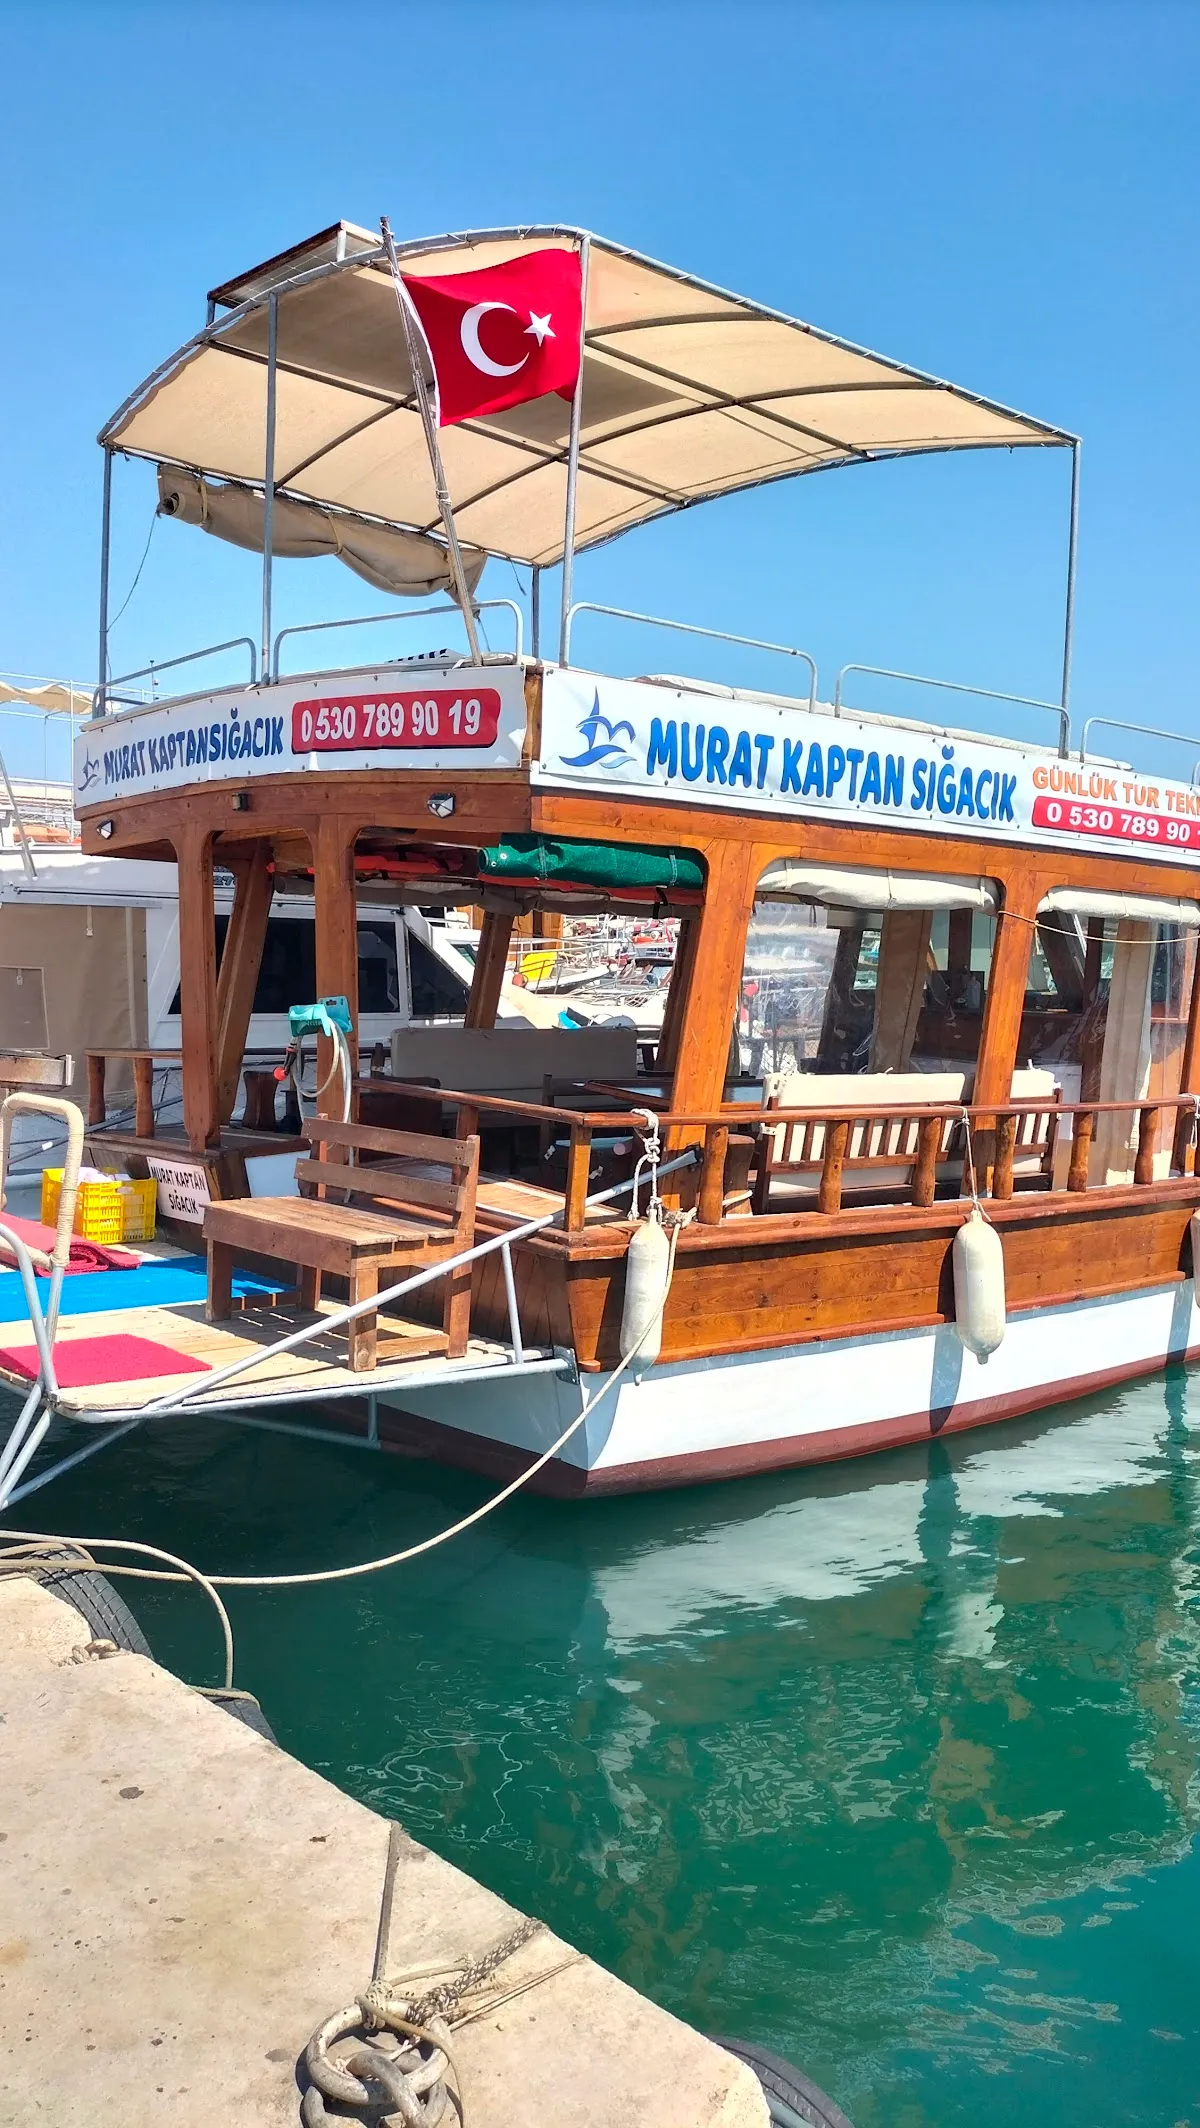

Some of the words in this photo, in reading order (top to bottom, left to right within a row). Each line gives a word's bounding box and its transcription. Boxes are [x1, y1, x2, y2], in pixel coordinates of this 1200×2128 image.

[302, 710, 312, 742] 0
[315, 705, 356, 740] 530
[363, 702, 404, 737] 789
[412, 700, 438, 736] 90
[448, 699, 481, 735] 19
[104, 741, 145, 785] MURAT
[647, 717, 775, 789] MURAT
[780, 738, 905, 807] KAPTAN
[911, 744, 1017, 823] SIĞACIK
[1032, 765, 1117, 801] GÜNLÜK
[1123, 782, 1159, 809] TUR
[1047, 803, 1062, 822] 0
[1069, 806, 1113, 830] 530
[1121, 814, 1159, 837] 789
[1166, 821, 1190, 842] 90
[150, 1166, 174, 1186] MURAT
[174, 1170, 206, 1192] KAPTAN
